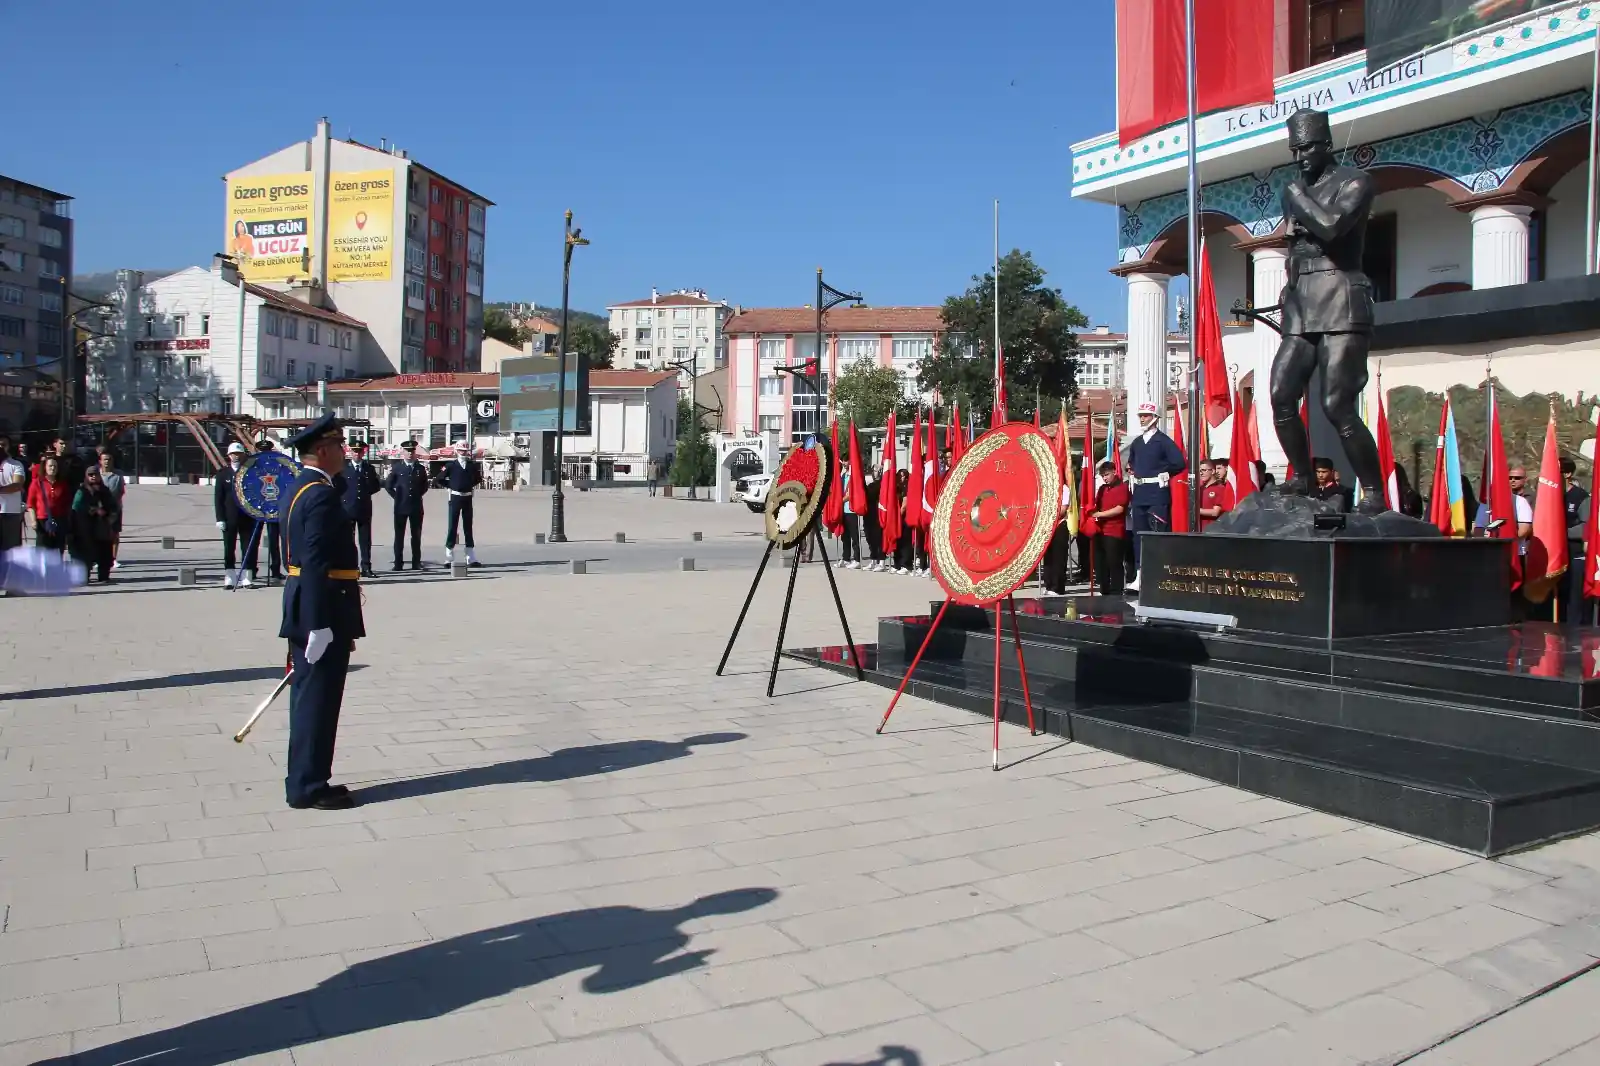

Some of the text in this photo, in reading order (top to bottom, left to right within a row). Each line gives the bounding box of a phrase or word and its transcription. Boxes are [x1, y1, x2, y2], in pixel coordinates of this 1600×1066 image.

[1259, 88, 1334, 122] KÜTAHYA
[234, 184, 308, 202] özen gross
[334, 179, 389, 192] özen gross
[284, 204, 308, 212] market
[253, 220, 303, 235] HER GÜN
[258, 238, 300, 255] UCUZ
